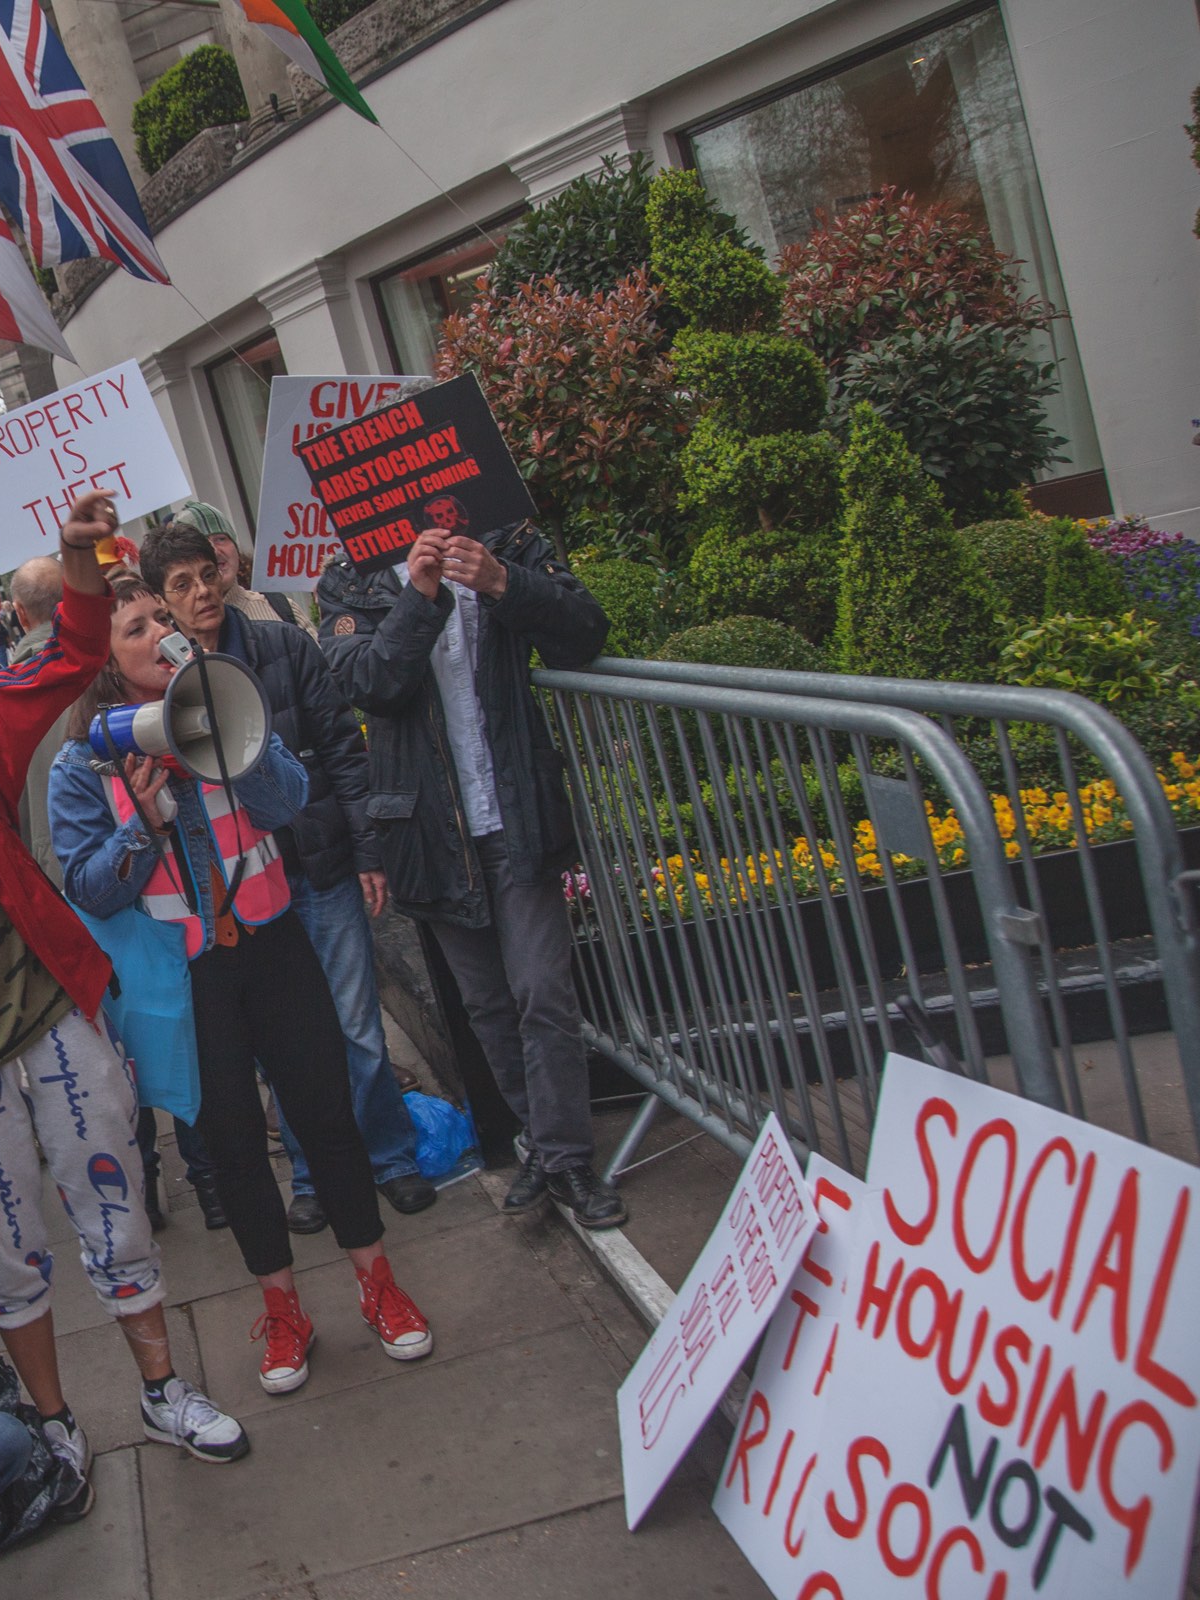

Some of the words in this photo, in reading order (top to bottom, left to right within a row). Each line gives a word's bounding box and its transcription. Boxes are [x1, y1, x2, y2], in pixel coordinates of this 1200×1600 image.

[49, 438, 88, 480] IS
[301, 436, 345, 471] THE
[339, 400, 425, 455] FRENCH
[318, 426, 461, 505] ARISTOCRACY
[332, 500, 376, 528] NEVER
[372, 487, 407, 513] SAW
[405, 480, 422, 501] IT
[420, 458, 481, 494] COMING
[883, 1096, 1198, 1408] SOCIAL
[856, 1241, 1175, 1579] HOUSING
[927, 1402, 1095, 1591] NOT
